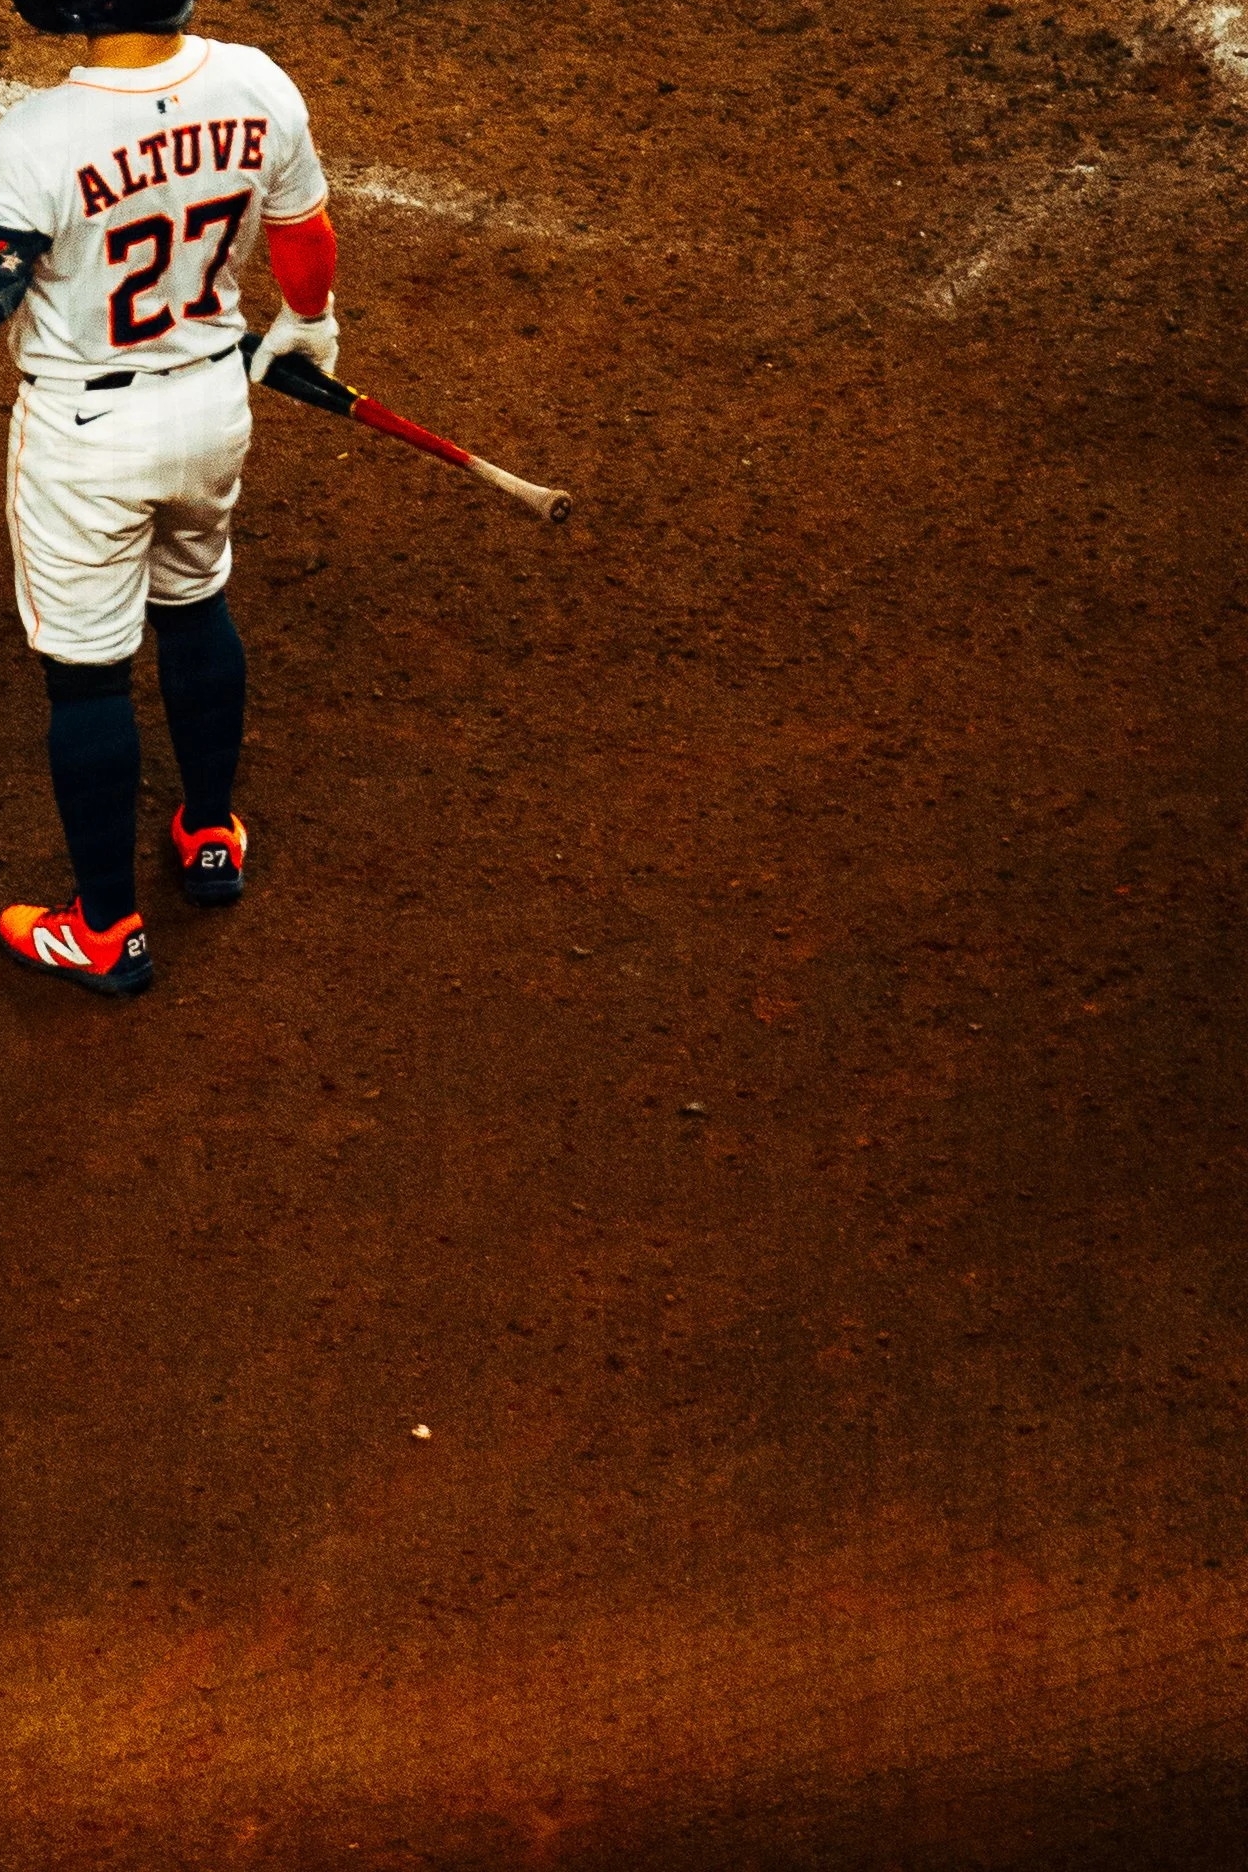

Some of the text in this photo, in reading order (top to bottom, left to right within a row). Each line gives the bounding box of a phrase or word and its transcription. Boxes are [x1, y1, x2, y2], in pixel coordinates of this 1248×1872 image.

[77, 118, 267, 217] ALTUVE
[105, 187, 252, 347] 27
[201, 849, 227, 869] 27
